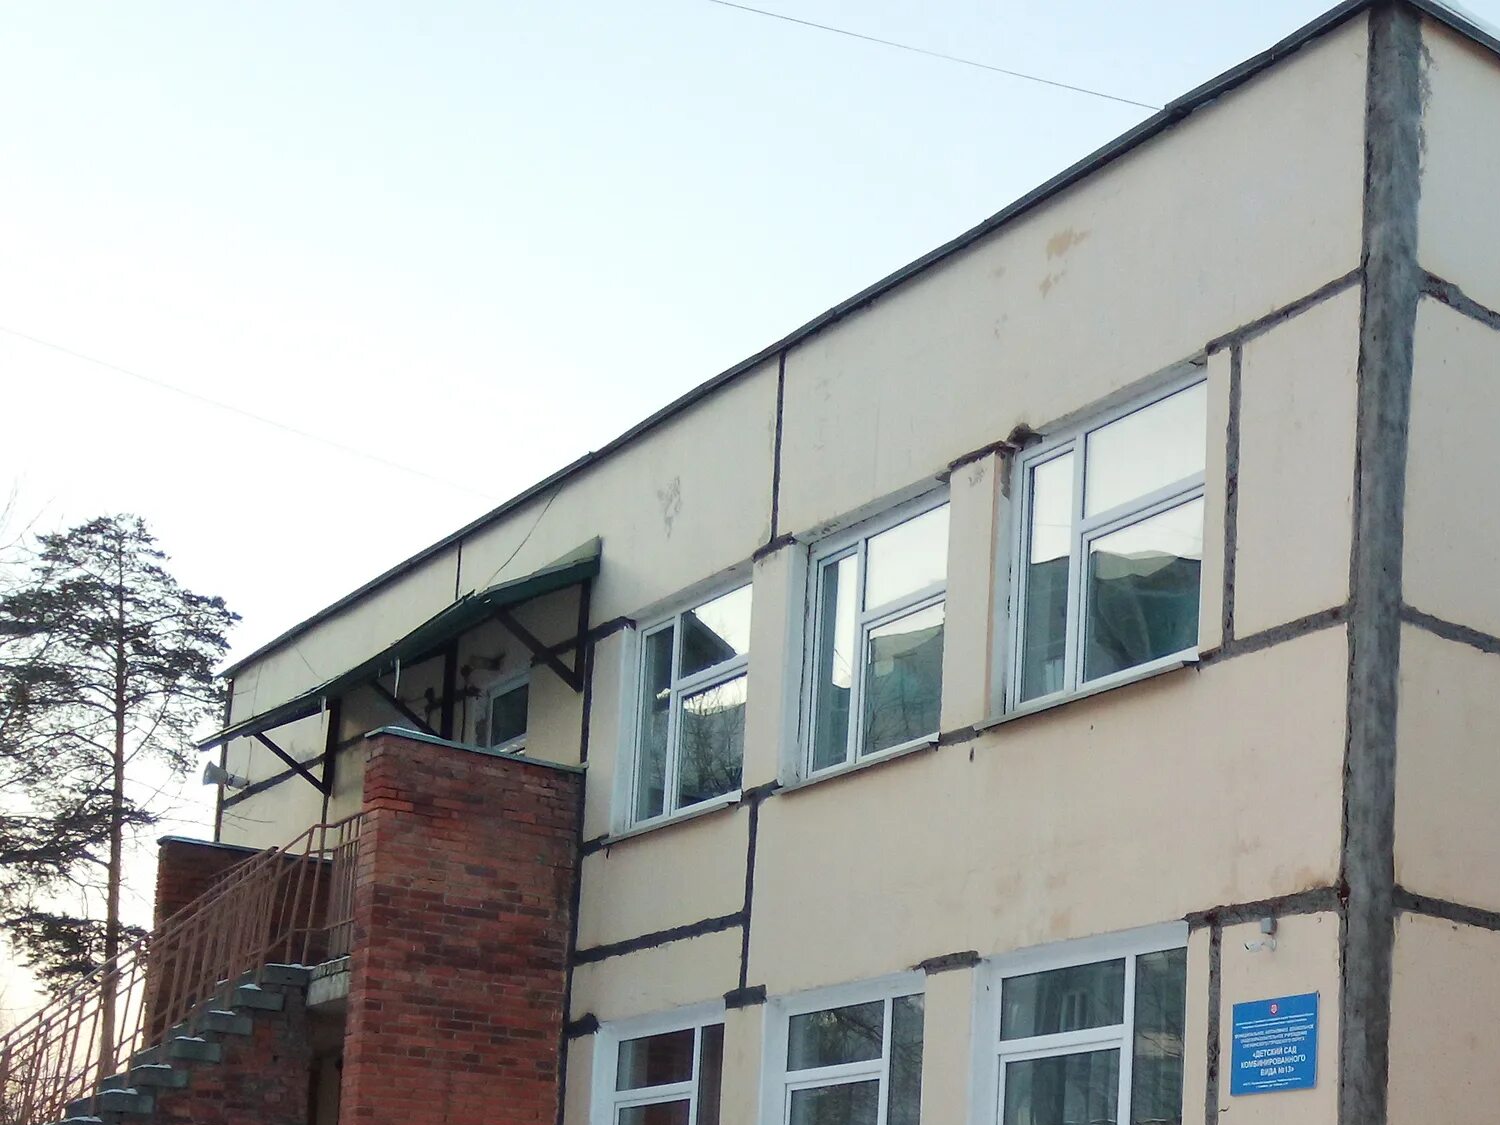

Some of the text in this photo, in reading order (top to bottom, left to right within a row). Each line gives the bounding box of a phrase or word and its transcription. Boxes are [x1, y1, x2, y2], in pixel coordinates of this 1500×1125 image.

[1284, 1046, 1297, 1055] САД
[1241, 1054, 1306, 1069] КОМБИНИРОВАННОГО
[1260, 1067, 1277, 1077] ВИДА
